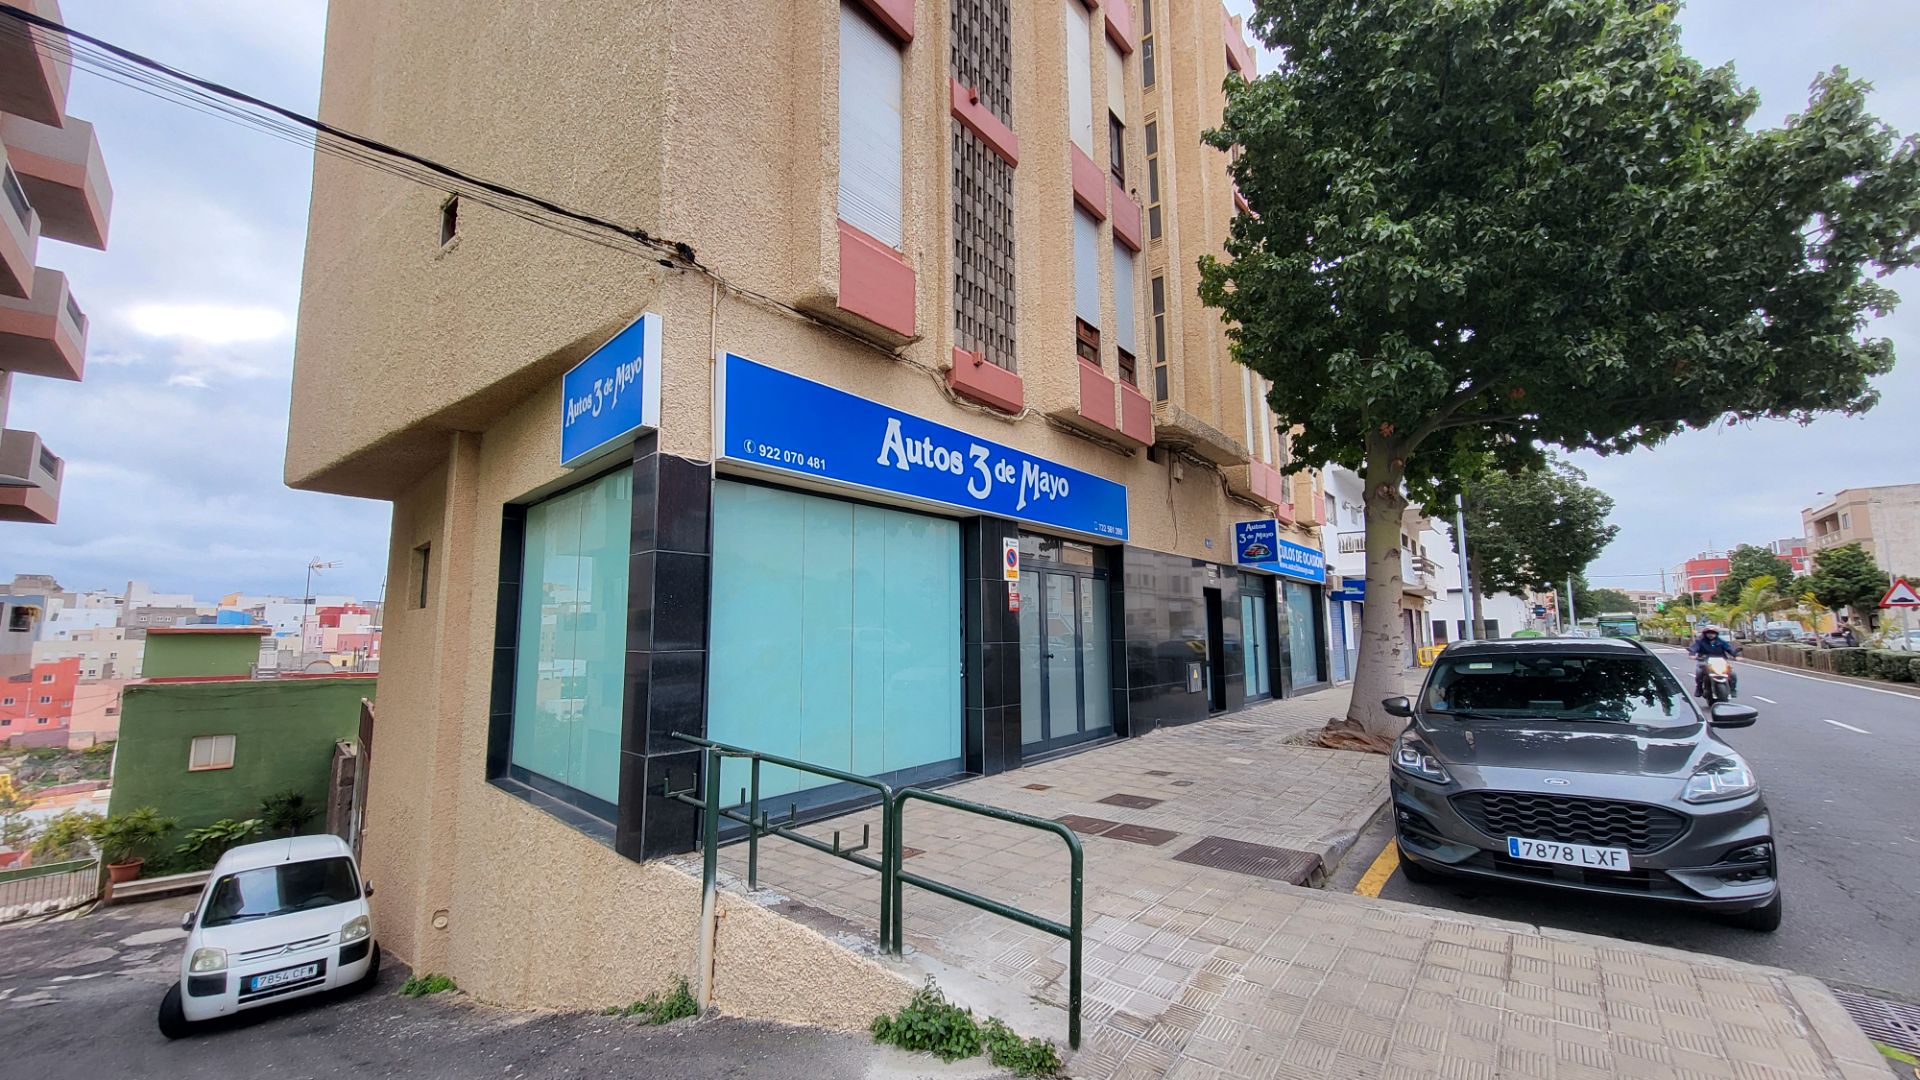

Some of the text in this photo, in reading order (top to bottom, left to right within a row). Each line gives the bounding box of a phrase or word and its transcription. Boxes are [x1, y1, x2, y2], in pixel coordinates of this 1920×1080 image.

[565, 357, 642, 427] Autos 3 de Mayo
[759, 444, 826, 470] 922 070 481
[877, 417, 1069, 511] Autos 3 de Mayo
[1245, 523, 1266, 532] Autos
[1239, 533, 1247, 544] 3
[1254, 532, 1274, 543] Mayo
[1295, 549, 1303, 563] DE
[1522, 841, 1622, 867] 7878 LXF
[260, 972, 288, 986] 7854
